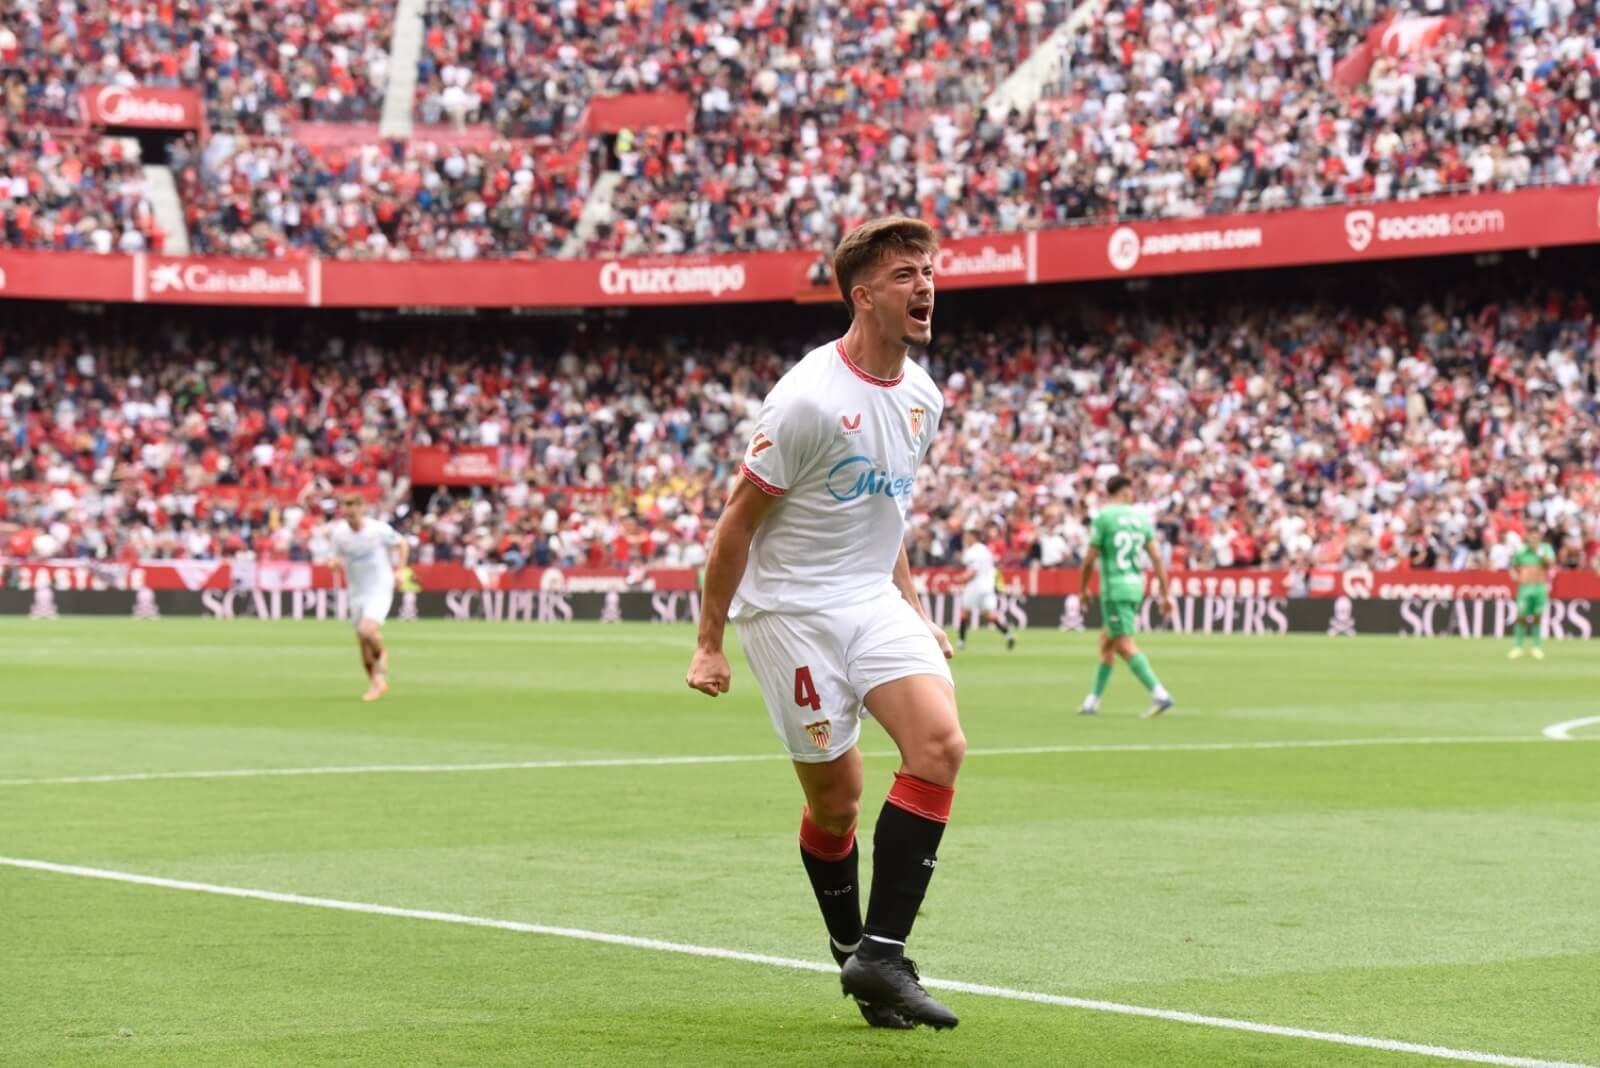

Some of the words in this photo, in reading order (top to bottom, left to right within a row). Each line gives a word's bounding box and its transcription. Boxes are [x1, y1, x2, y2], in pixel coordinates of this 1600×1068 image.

[933, 244, 1025, 277] CaixaBank
[183, 264, 304, 293] CaixaBank
[600, 262, 746, 296] Cruzcampo
[201, 587, 351, 621] SCALPE
[1136, 595, 1289, 633] CALPERS
[1400, 598, 1592, 639] SCALPRS
[794, 665, 821, 711] 4
